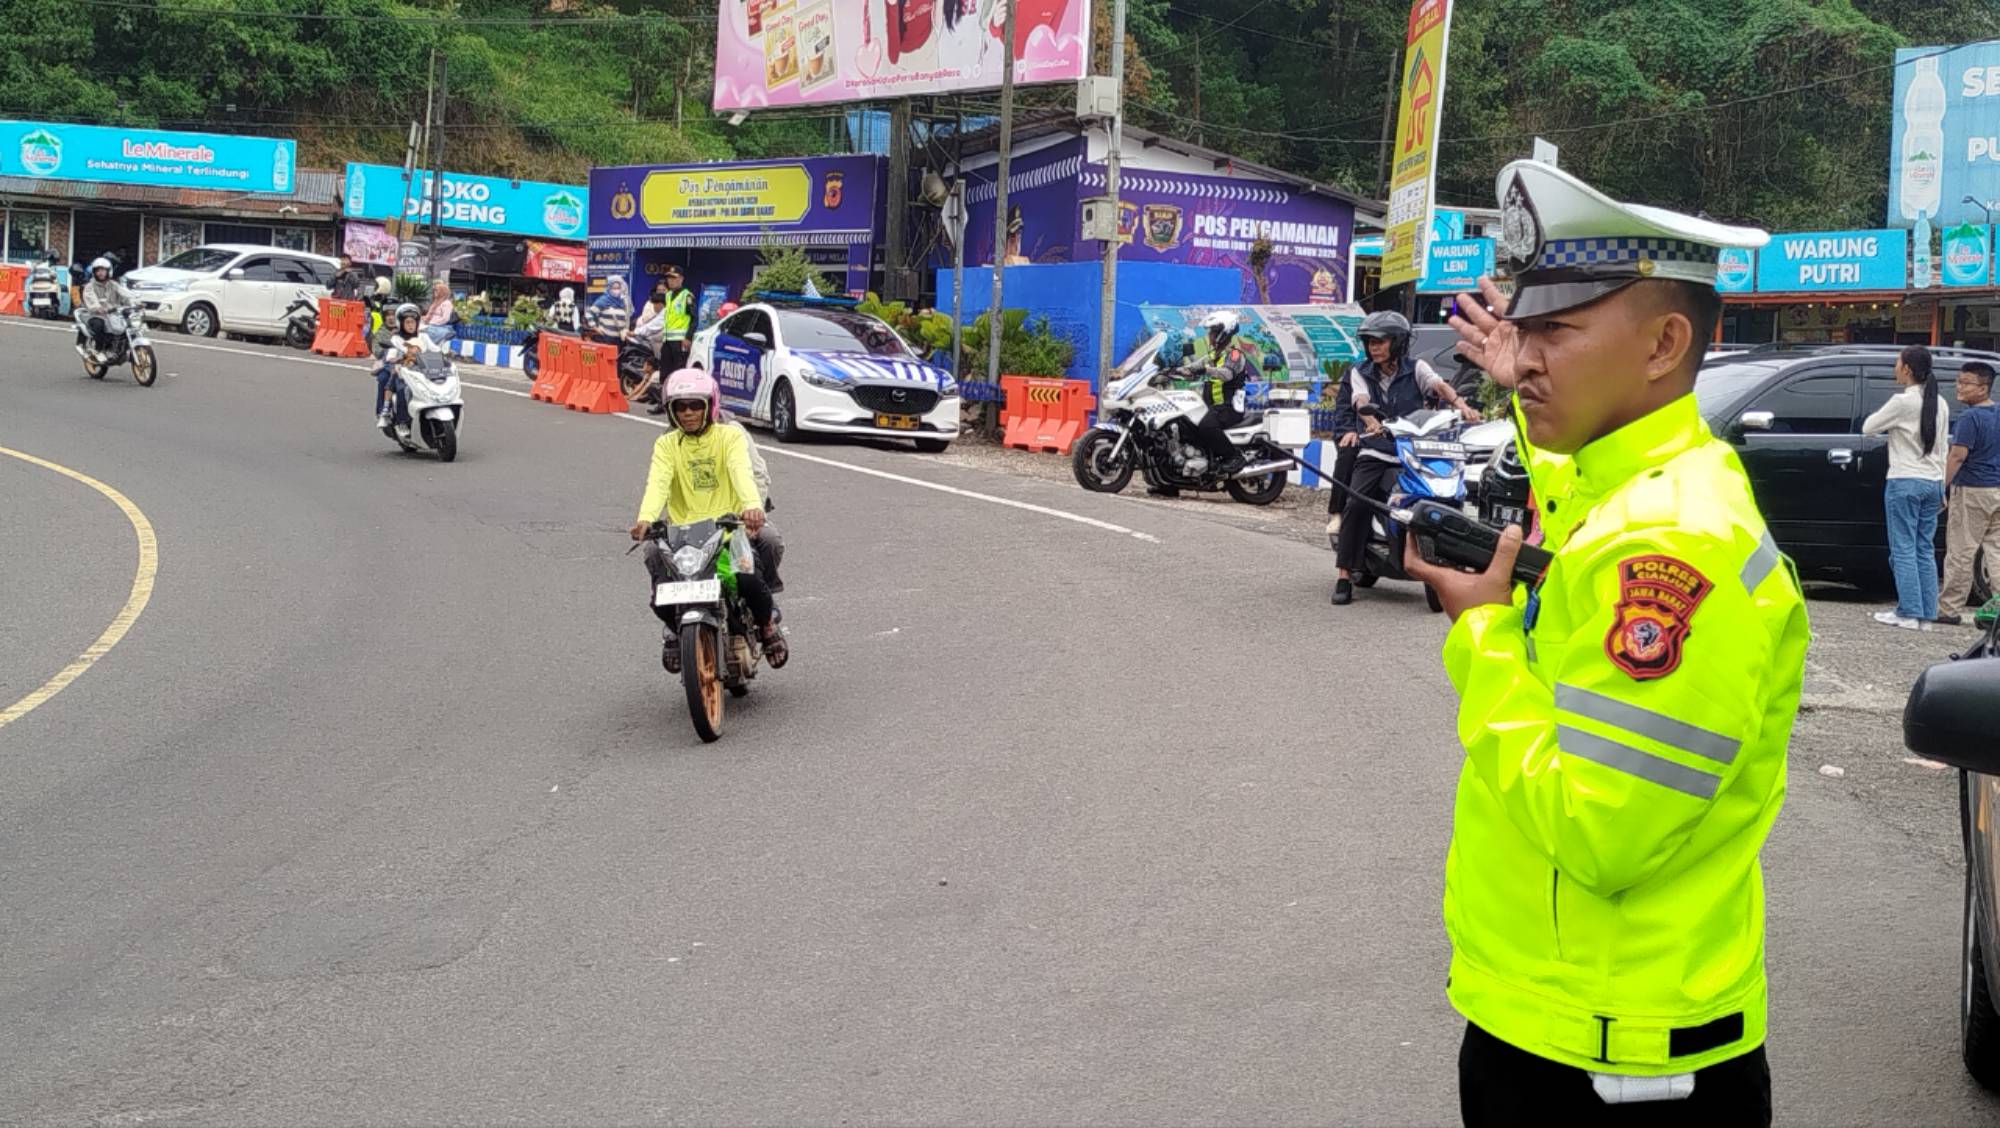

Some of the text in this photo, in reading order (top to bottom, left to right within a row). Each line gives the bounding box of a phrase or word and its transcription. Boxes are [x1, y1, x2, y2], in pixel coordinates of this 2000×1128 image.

[123, 139, 214, 163] LeMinerale
[87, 160, 250, 179] Sehatnya Mineral Terlindungi
[424, 178, 490, 202] TOKO
[679, 176, 768, 196] Pos Pengamanan
[1194, 214, 1339, 246] POS PENGAMANAN
[1433, 244, 1480, 258] WARUNG
[1784, 237, 1877, 260] WARUNG
[1443, 260, 1467, 272] LENI
[1800, 263, 1860, 284] PUTRI
[720, 360, 746, 380] POLISI
[1632, 561, 1698, 587] POLRES
[1636, 571, 1692, 594] CIANJUR
[1629, 587, 1656, 598] JAWA
